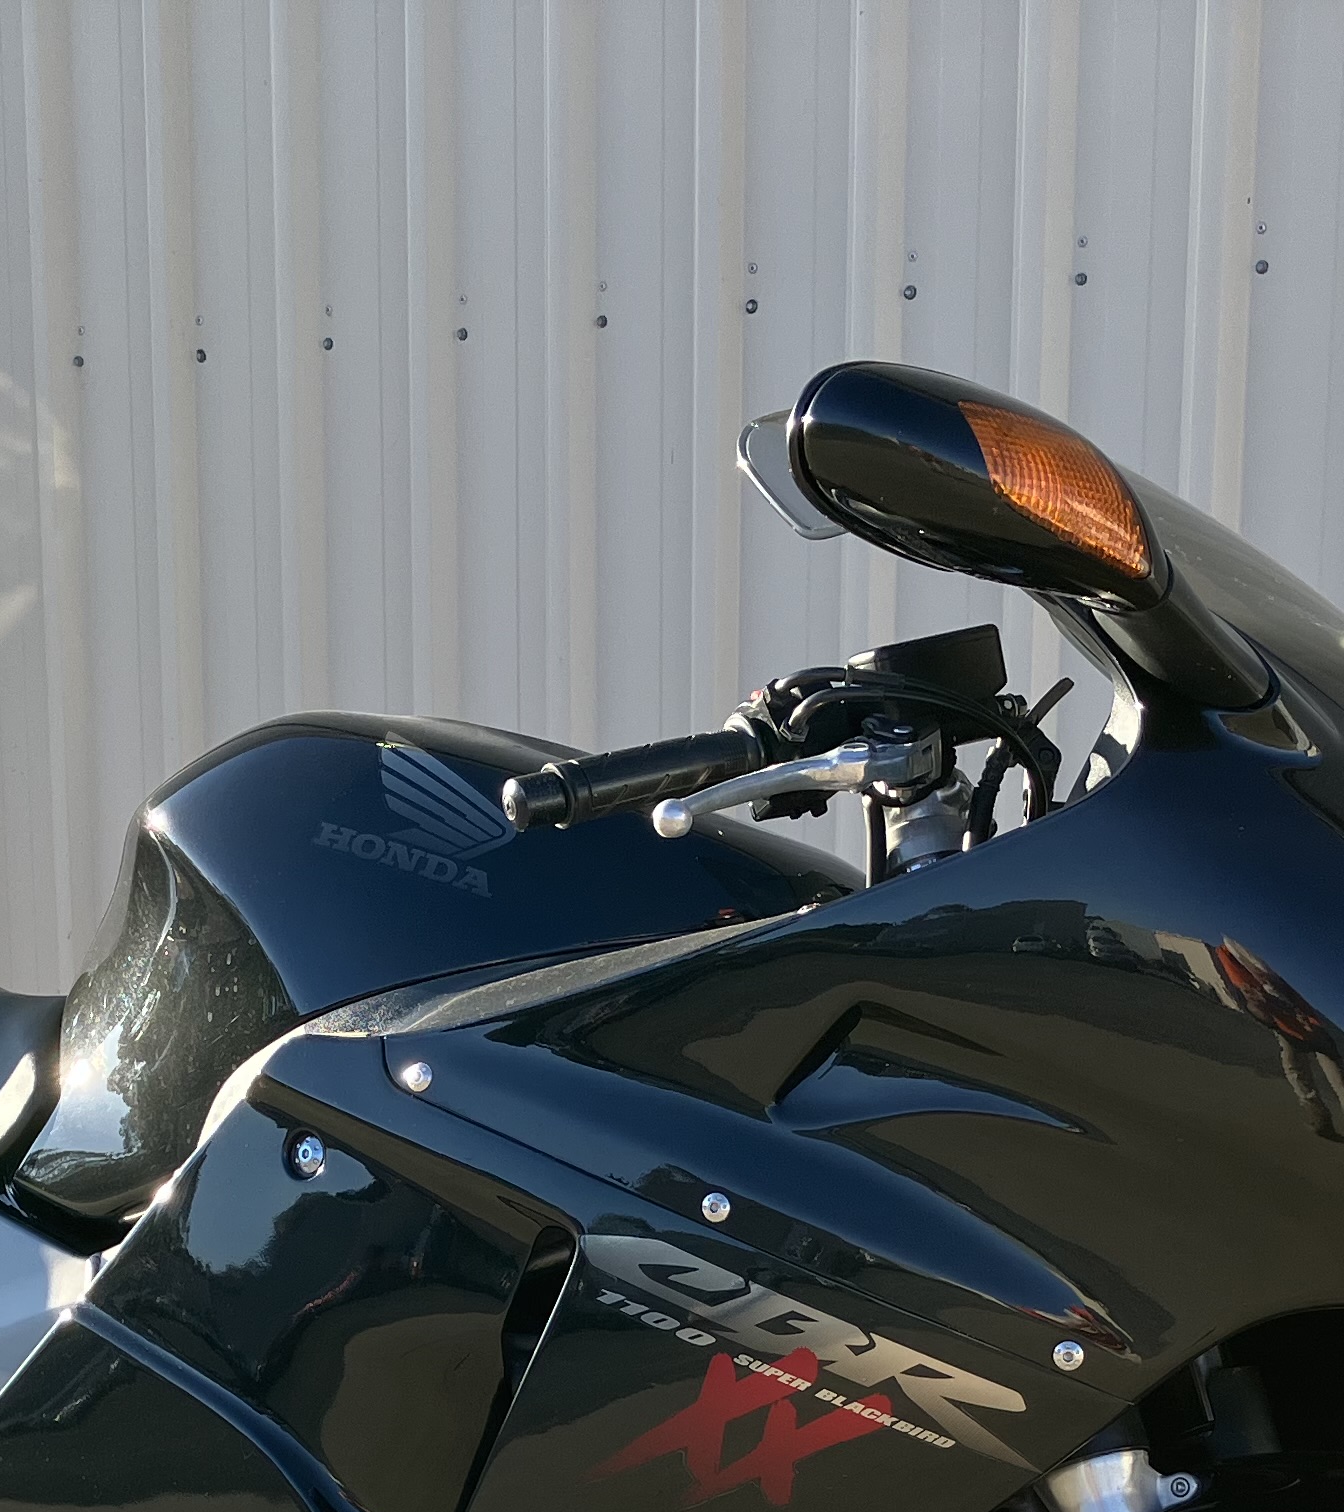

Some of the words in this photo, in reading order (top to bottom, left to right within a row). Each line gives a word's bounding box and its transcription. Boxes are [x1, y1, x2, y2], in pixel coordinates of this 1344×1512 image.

[313, 820, 493, 899] HONDA
[580, 1234, 1043, 1473] CBR
[596, 1289, 717, 1347] 1100
[585, 1346, 892, 1512] XX
[733, 1353, 812, 1391] SUPER
[815, 1388, 956, 1448] BLACKBIRD
